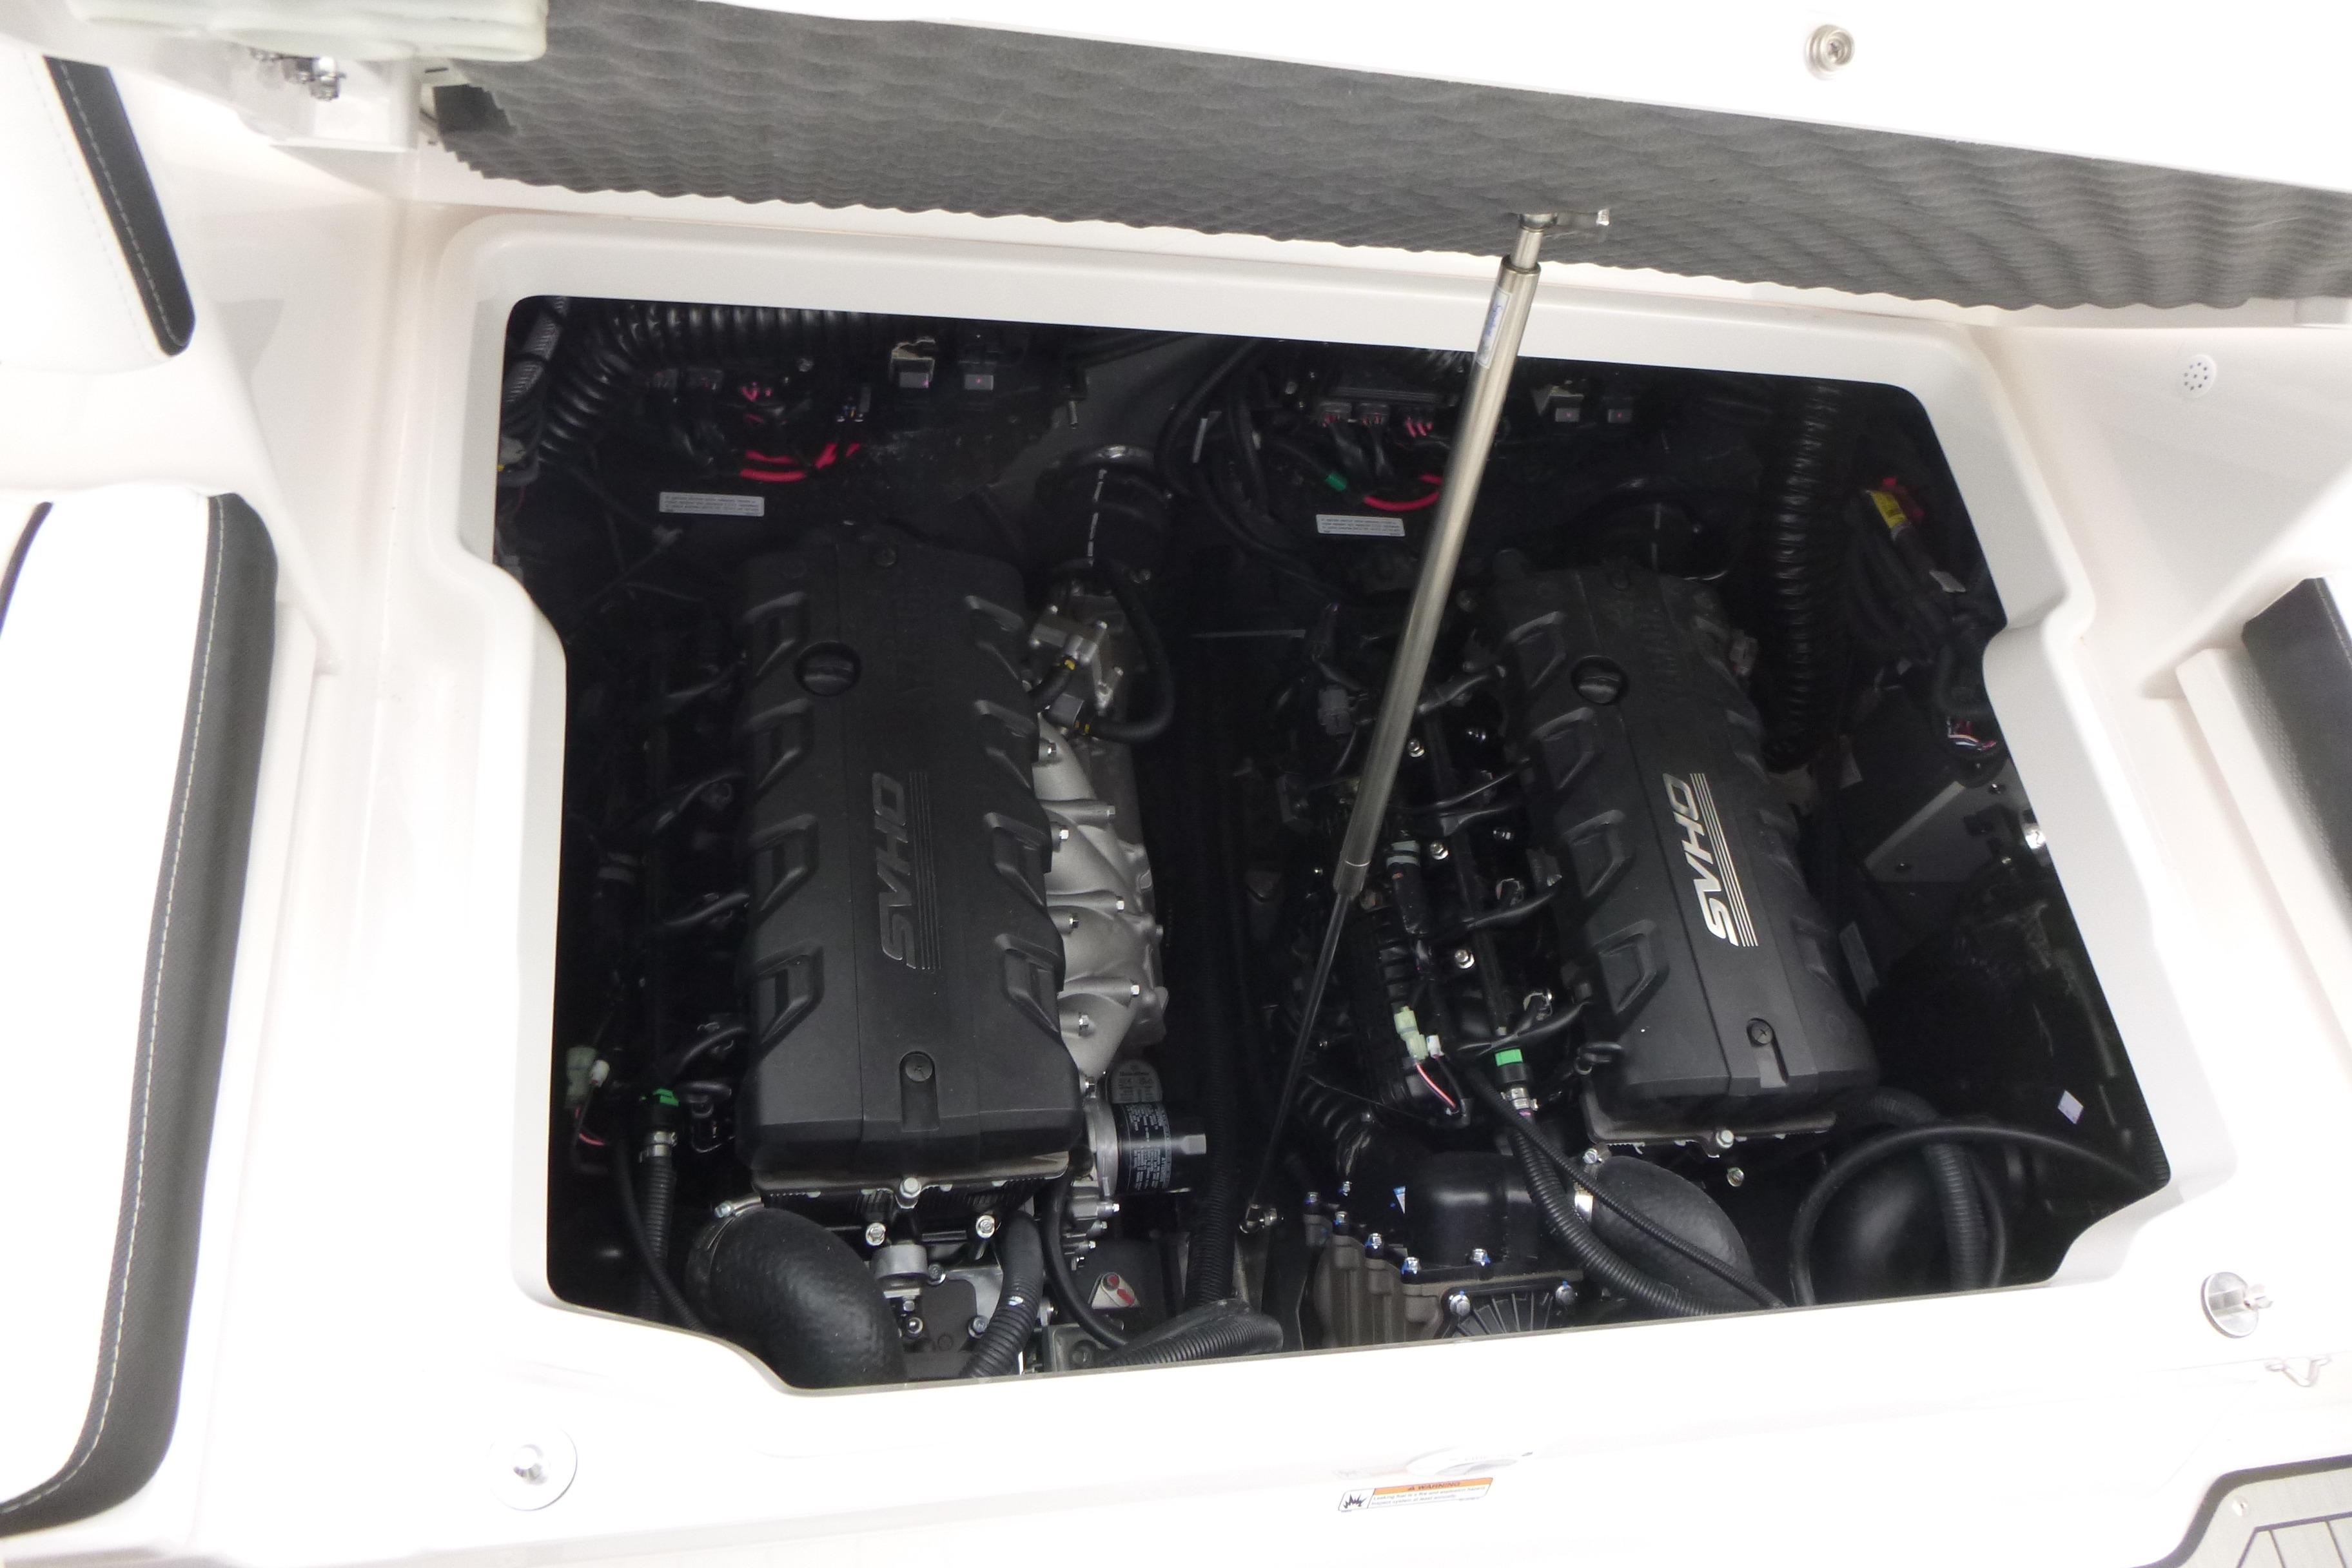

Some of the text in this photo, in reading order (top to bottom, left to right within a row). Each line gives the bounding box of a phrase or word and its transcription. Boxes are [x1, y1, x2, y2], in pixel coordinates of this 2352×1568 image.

[872, 772, 916, 969] SVHO
[1662, 773, 1739, 946] SVHO
[1418, 1481, 1461, 1491] WARNING
